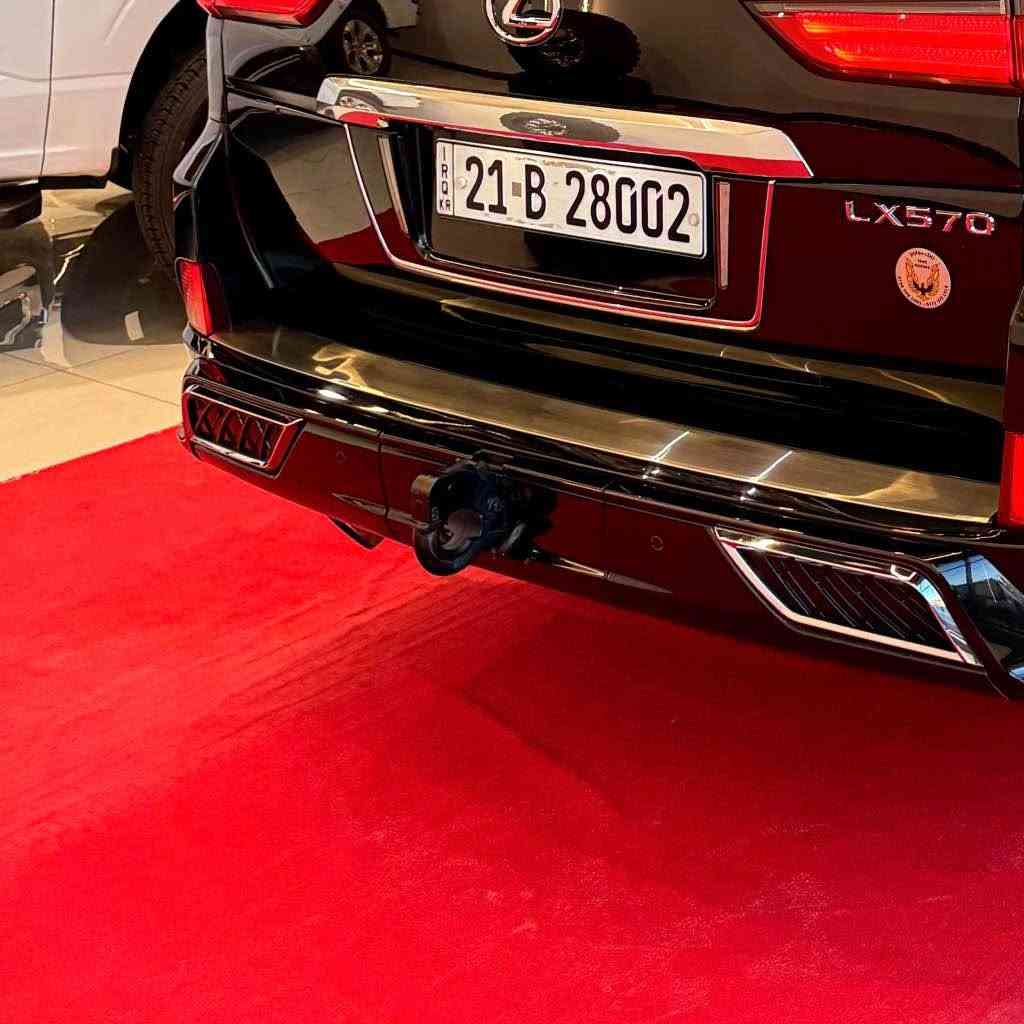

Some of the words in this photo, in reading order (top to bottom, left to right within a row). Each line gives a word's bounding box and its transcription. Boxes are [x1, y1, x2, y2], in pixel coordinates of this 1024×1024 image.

[466, 156, 508, 215] 21
[524, 164, 546, 219] B
[565, 170, 690, 243] 28002
